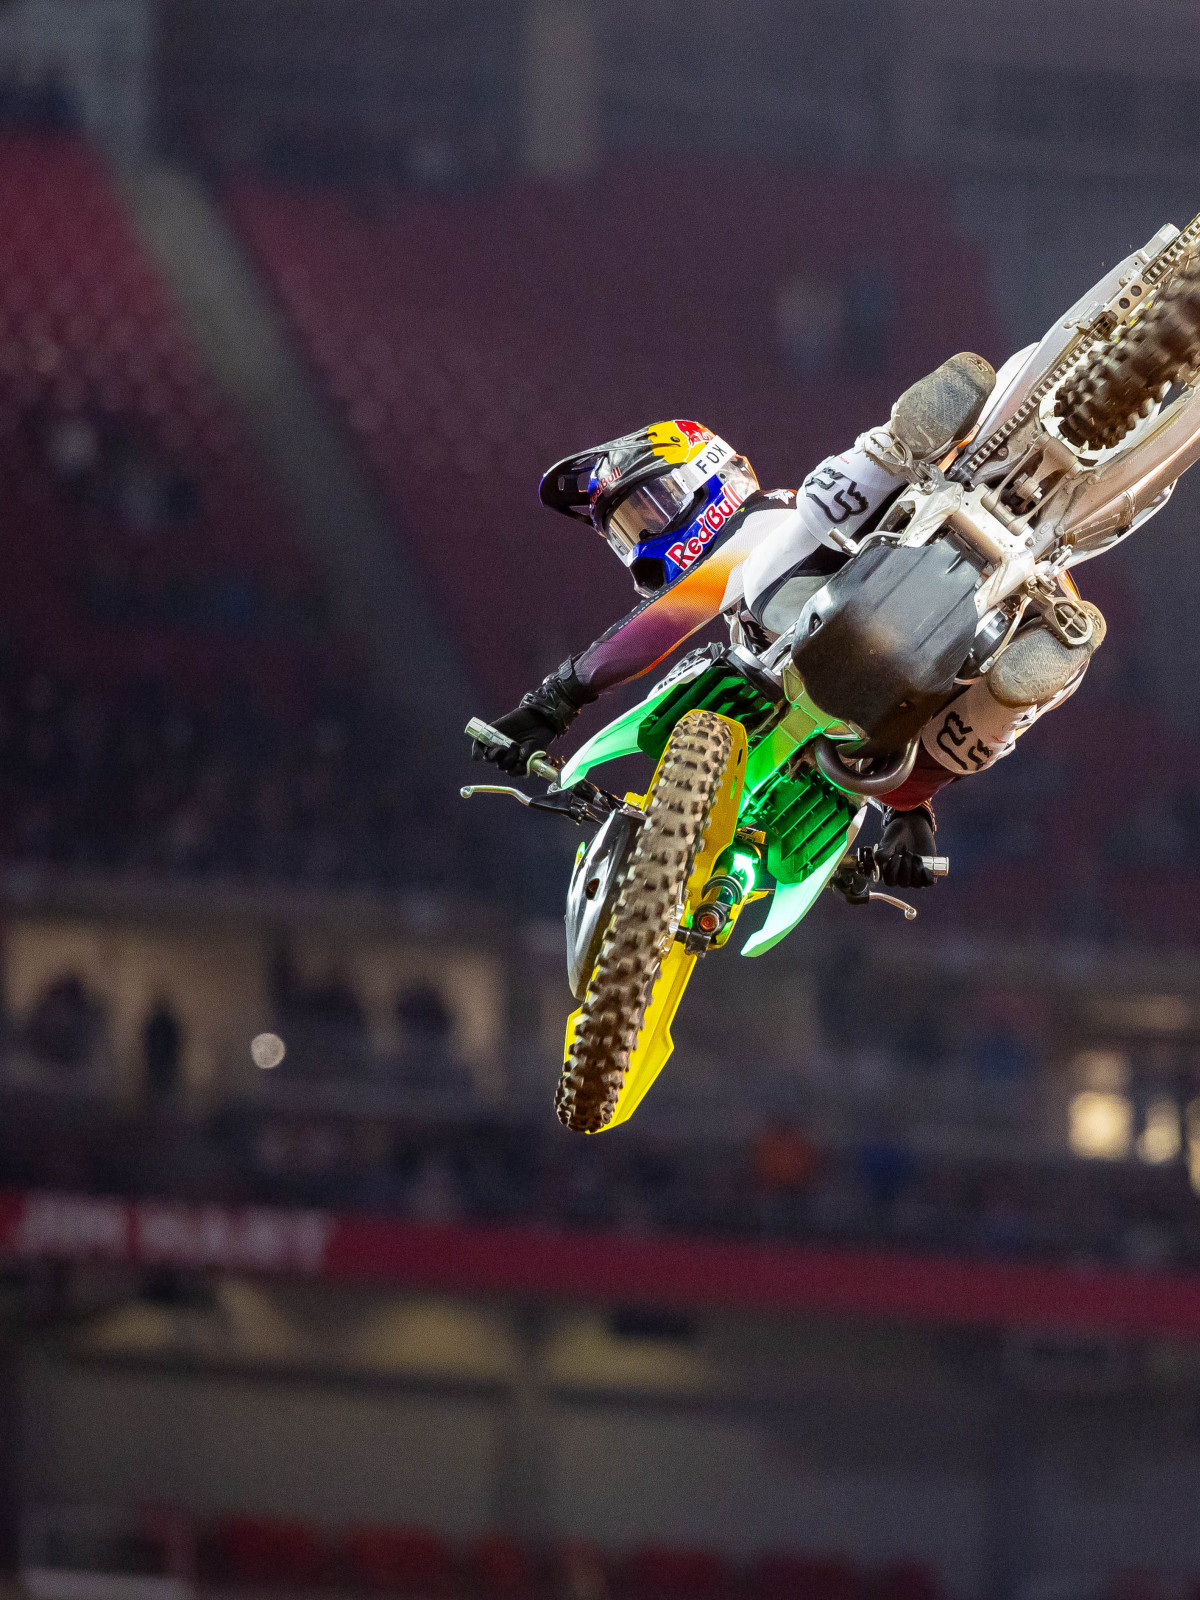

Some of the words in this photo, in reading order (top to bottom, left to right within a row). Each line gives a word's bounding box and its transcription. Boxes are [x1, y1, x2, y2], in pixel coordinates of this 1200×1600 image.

[696, 444, 727, 475] FOX
[601, 466, 622, 490] Bull
[665, 515, 715, 570] Red
[705, 482, 744, 530] Bull
